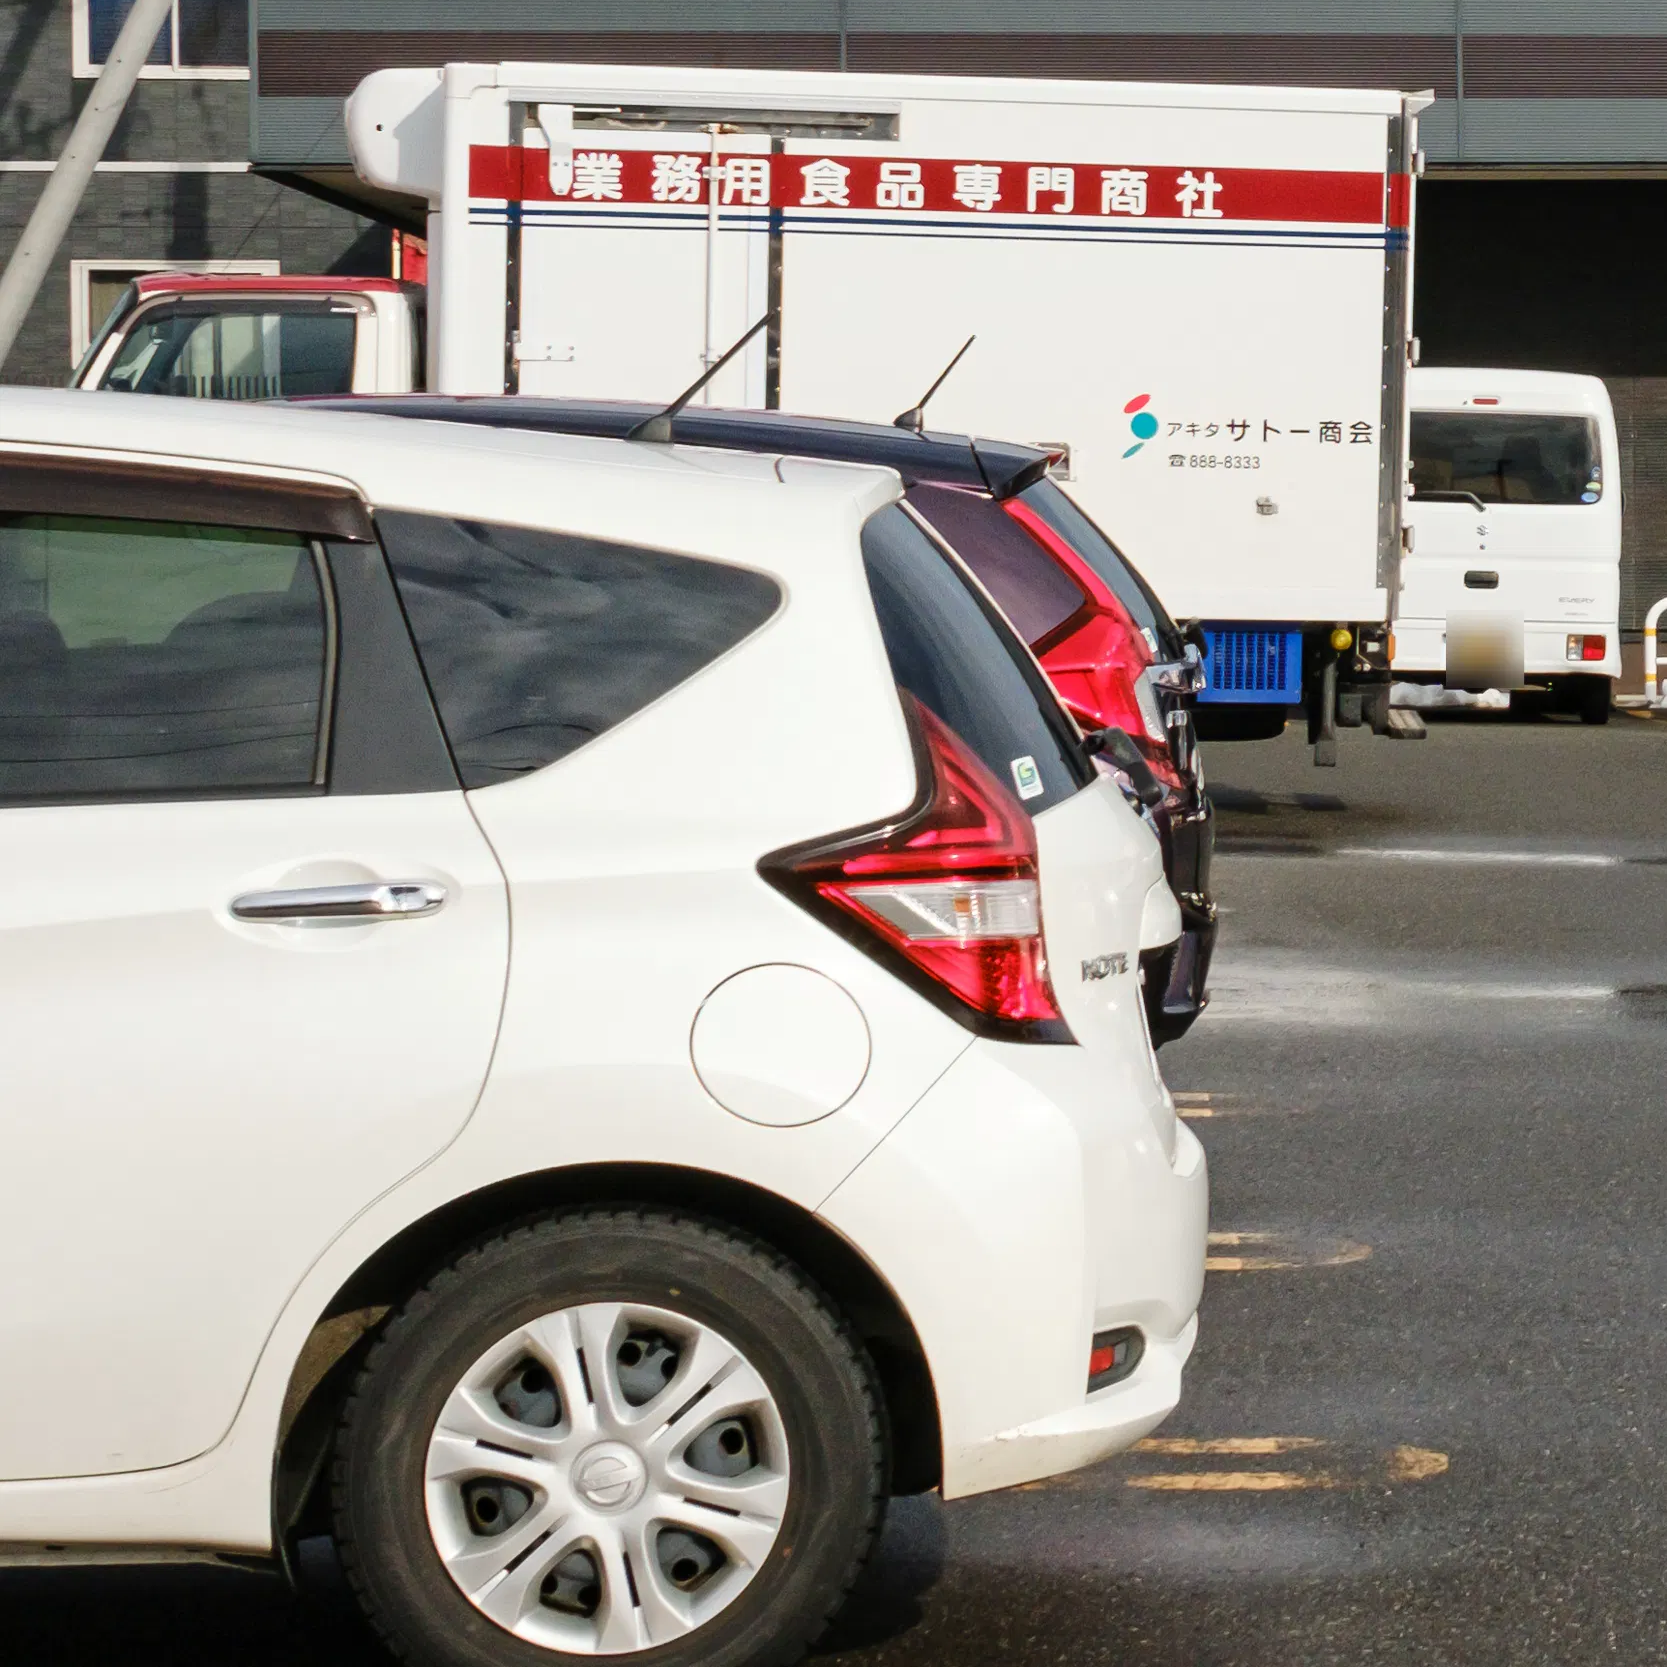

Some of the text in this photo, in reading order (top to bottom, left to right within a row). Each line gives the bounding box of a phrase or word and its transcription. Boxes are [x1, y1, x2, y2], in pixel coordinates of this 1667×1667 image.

[572, 153, 1224, 218] 業務用食品専門商社
[1189, 455, 1261, 469] 888-8333
